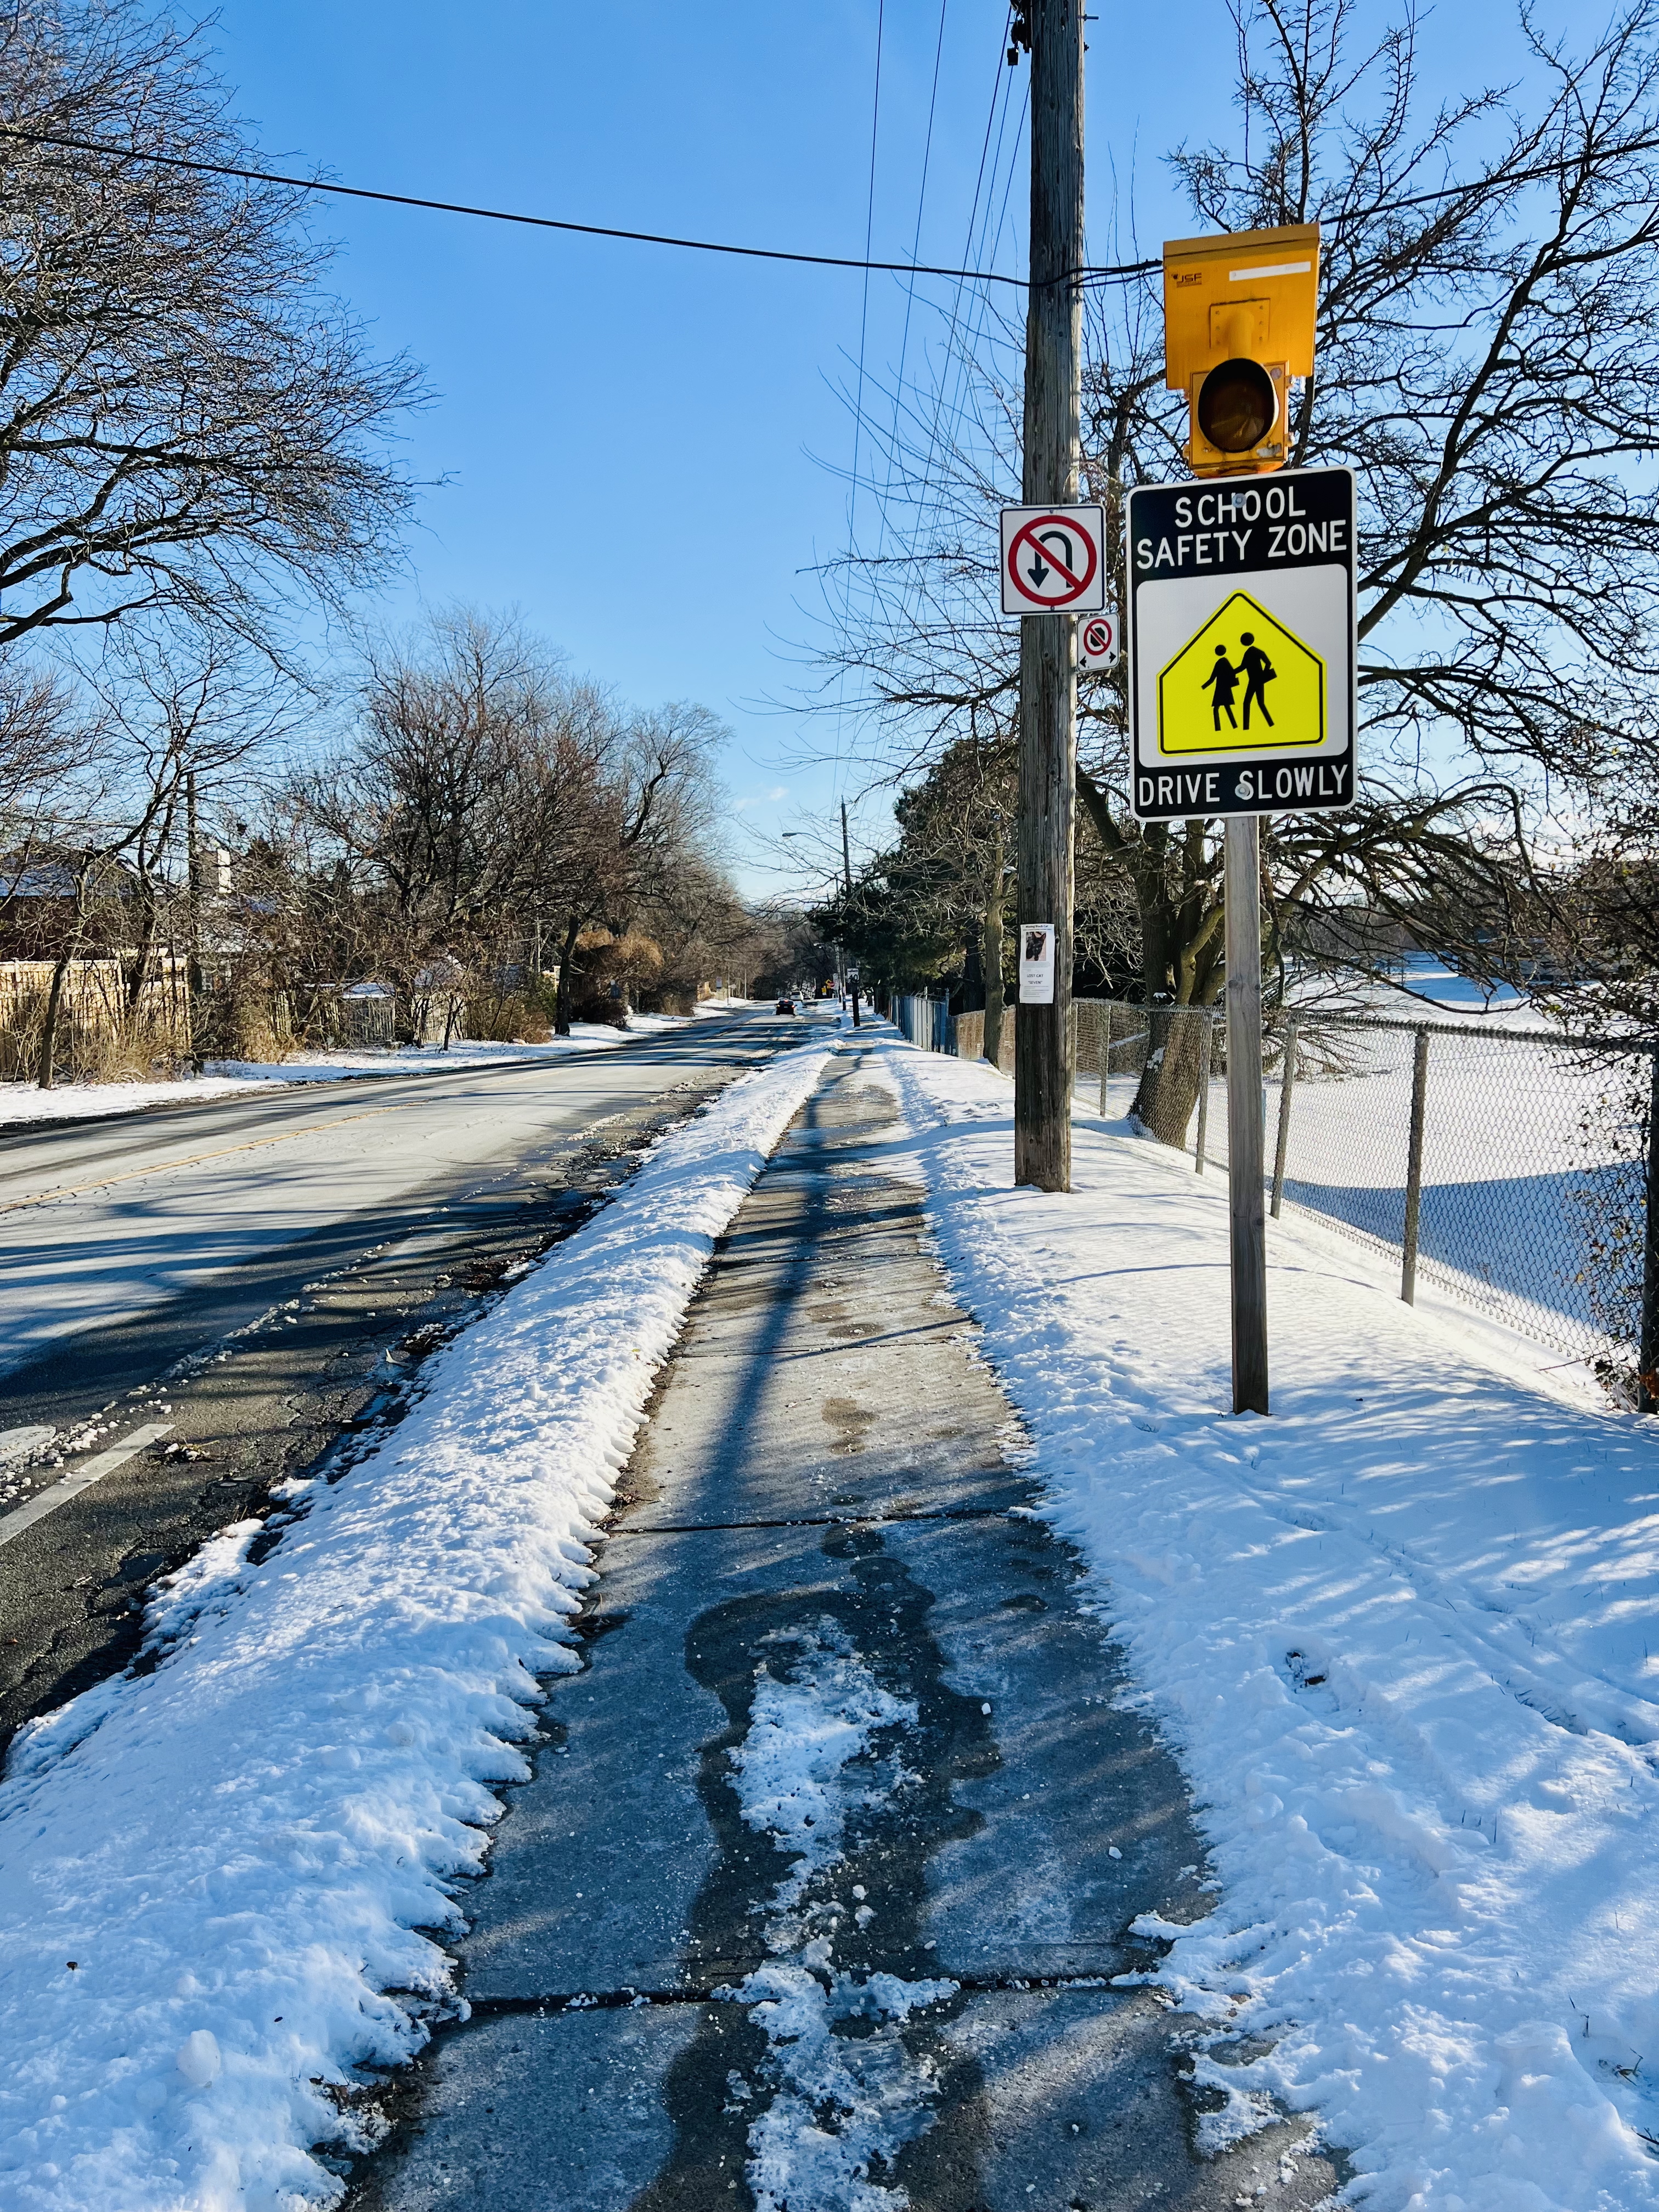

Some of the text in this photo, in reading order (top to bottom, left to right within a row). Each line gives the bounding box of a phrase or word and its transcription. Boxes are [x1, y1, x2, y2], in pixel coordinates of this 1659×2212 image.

[1175, 486, 1306, 528] SCHOOL
[1136, 519, 1347, 569] SAFETY ZONE
[1139, 764, 1348, 806] DRIVE SLOWLY
[848, 974, 859, 983] 40
